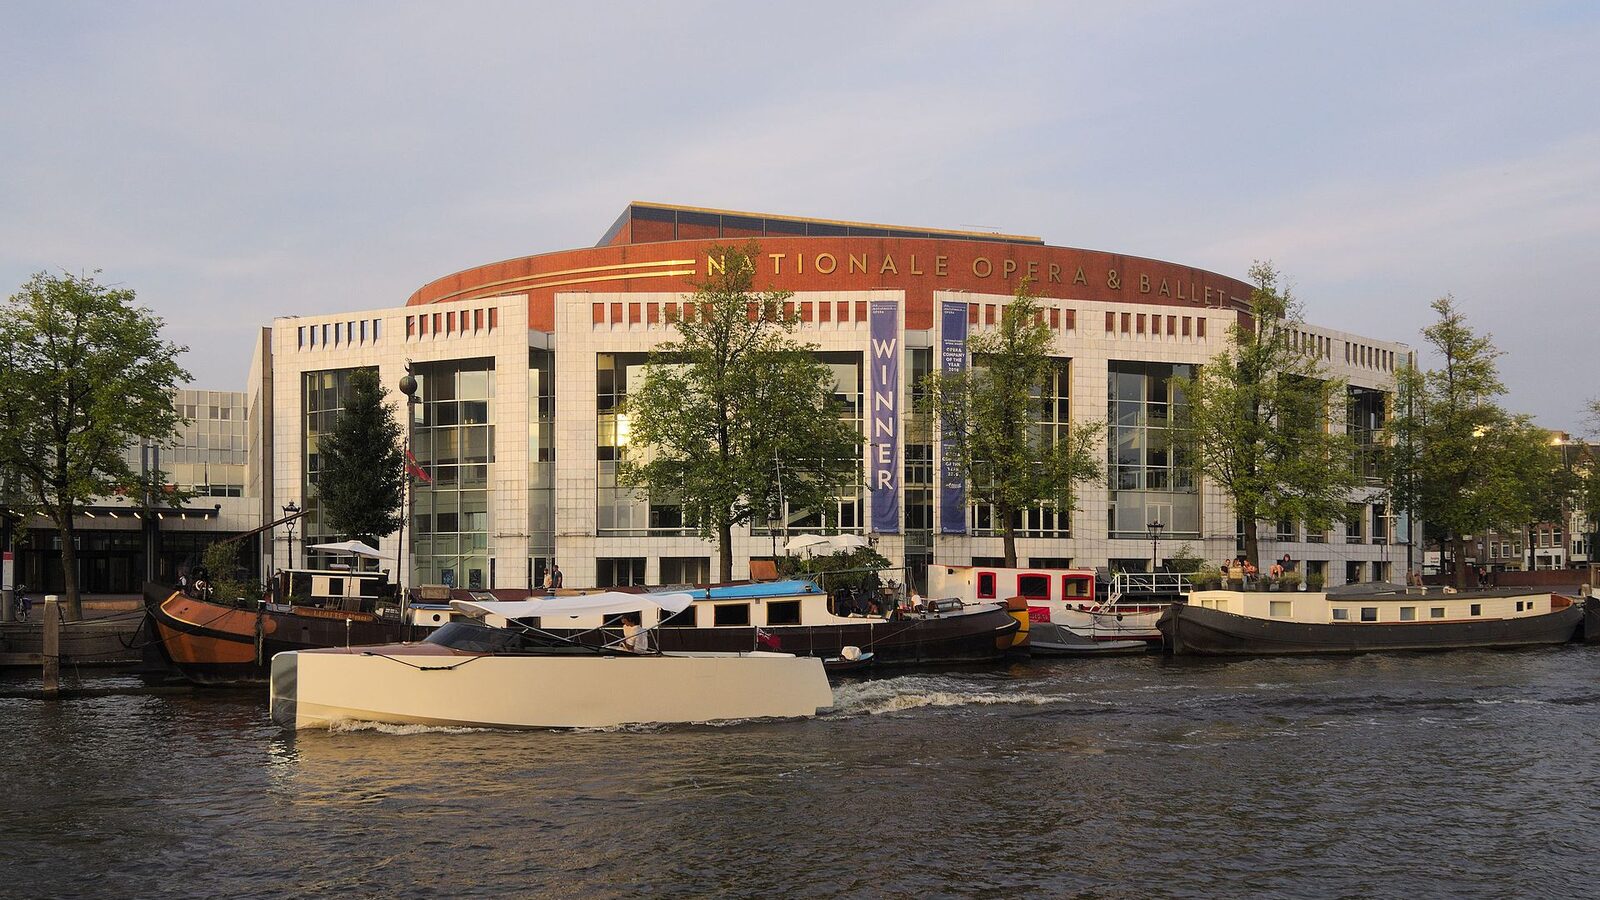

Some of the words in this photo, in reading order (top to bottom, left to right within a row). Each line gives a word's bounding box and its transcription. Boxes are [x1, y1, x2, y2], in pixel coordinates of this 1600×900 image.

[707, 252, 949, 276] NATIONALE
[972, 256, 1089, 286] OPERA
[1106, 269, 1122, 290] &
[1139, 273, 1226, 307] BALLET
[872, 338, 897, 490] WINNER
